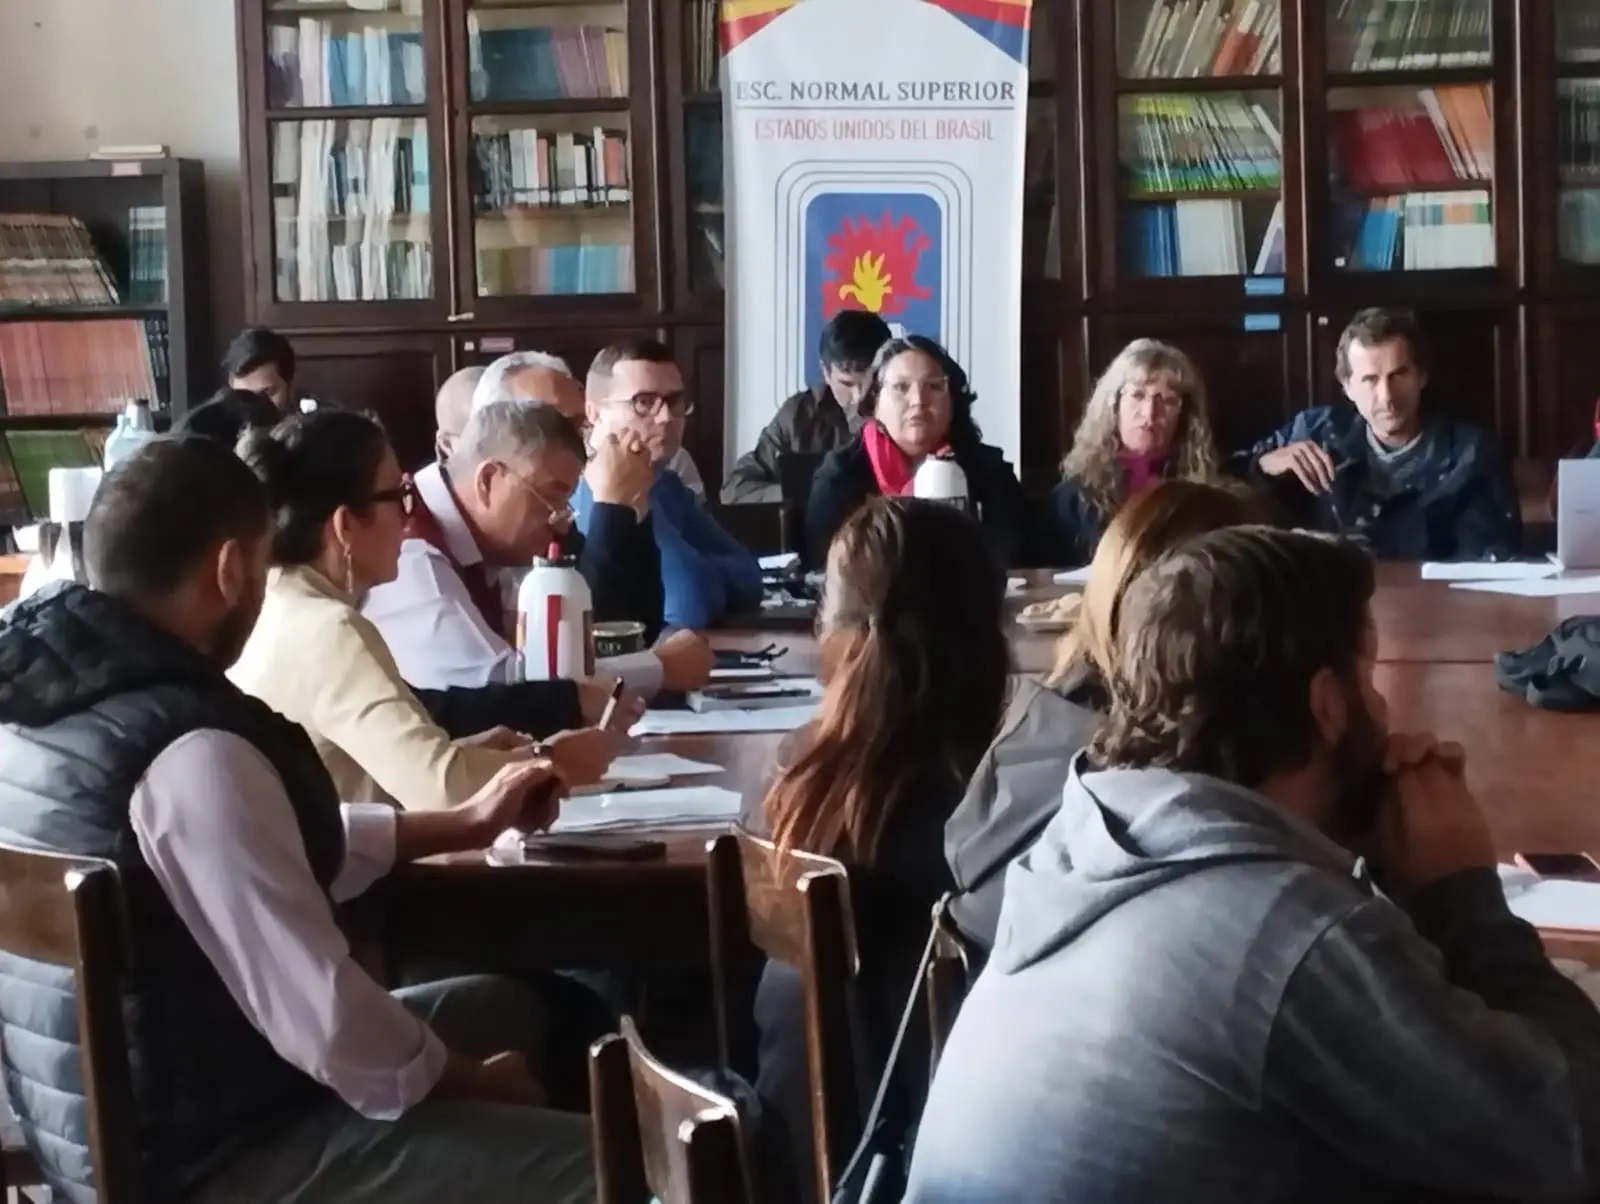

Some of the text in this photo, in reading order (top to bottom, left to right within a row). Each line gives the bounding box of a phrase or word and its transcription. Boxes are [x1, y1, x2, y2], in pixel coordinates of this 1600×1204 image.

[736, 81, 1015, 101] ESC. NORMAL SUPERIOR
[755, 119, 995, 140] ESTADOS UNIDOS DEL BRASIL
